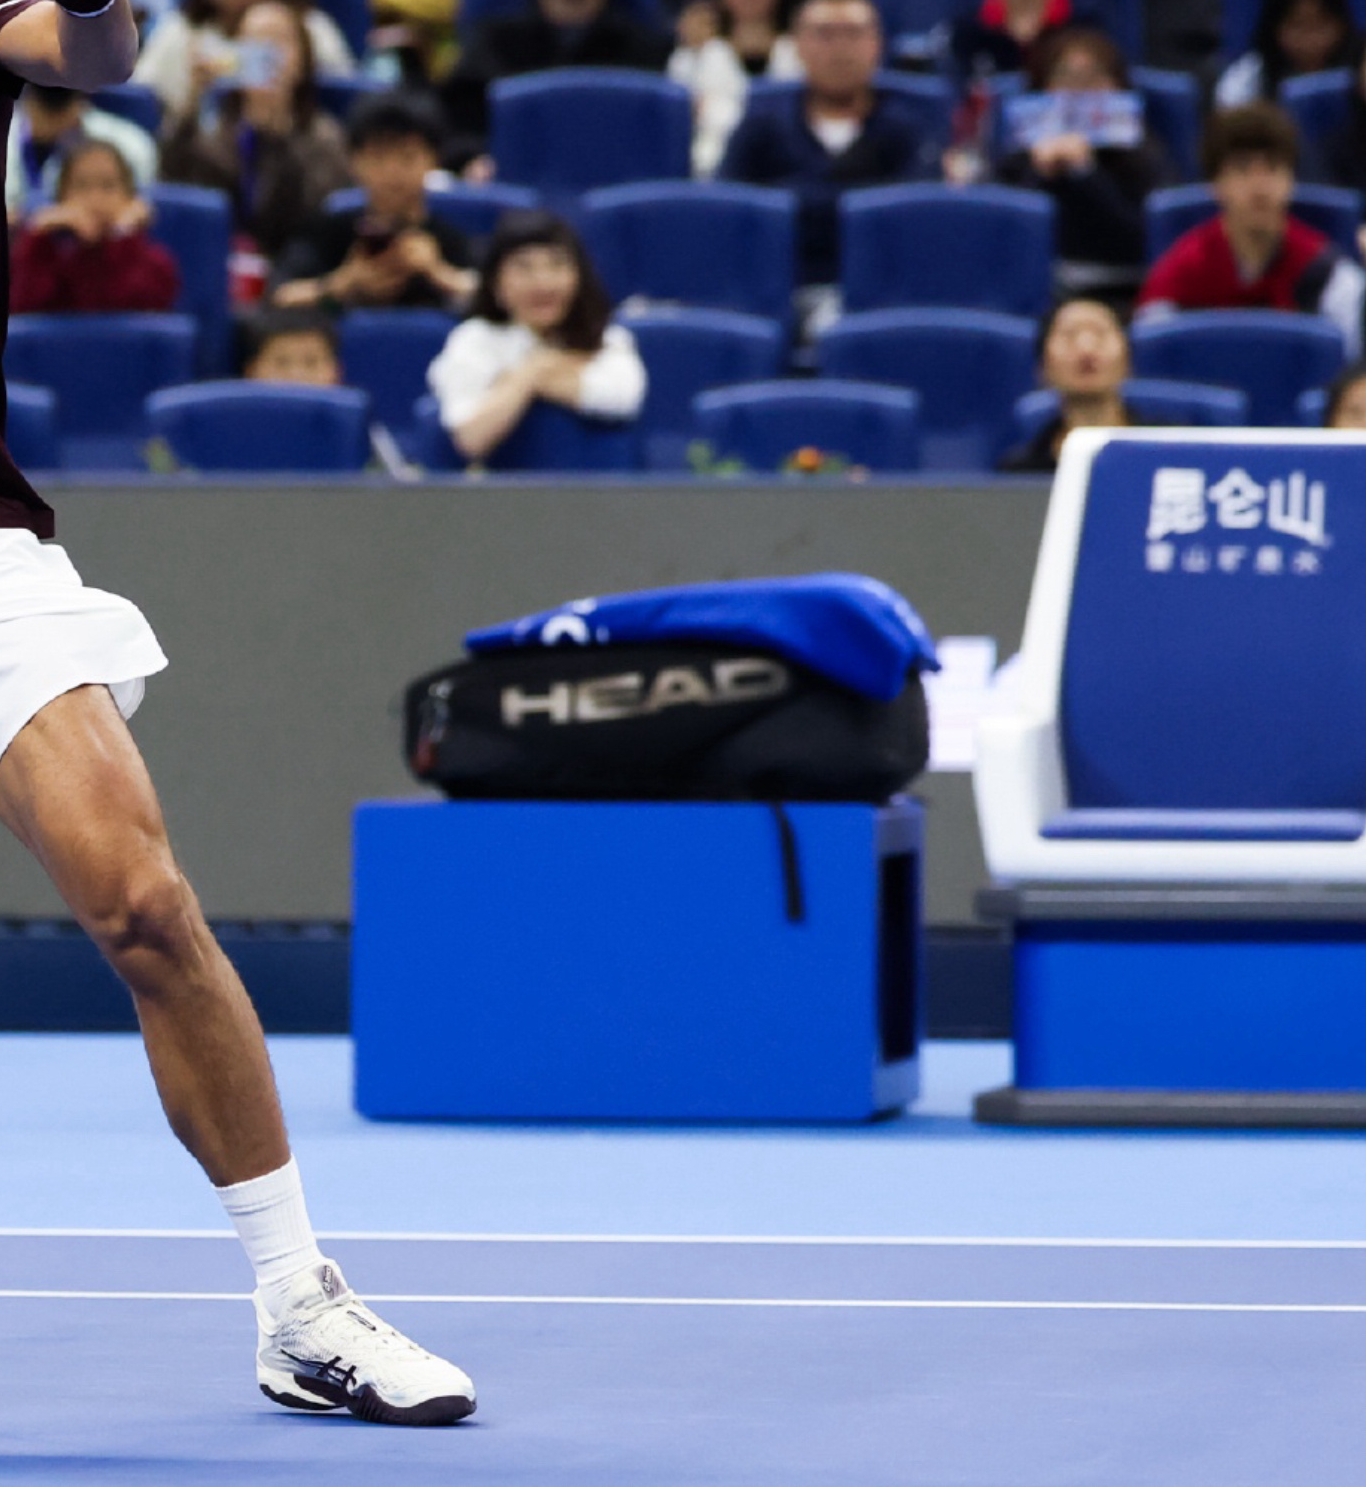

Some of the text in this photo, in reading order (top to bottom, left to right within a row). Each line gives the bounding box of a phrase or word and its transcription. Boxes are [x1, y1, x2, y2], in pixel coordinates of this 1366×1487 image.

[1146, 467, 1331, 543] 昆仑山
[501, 657, 790, 727] HEAD
